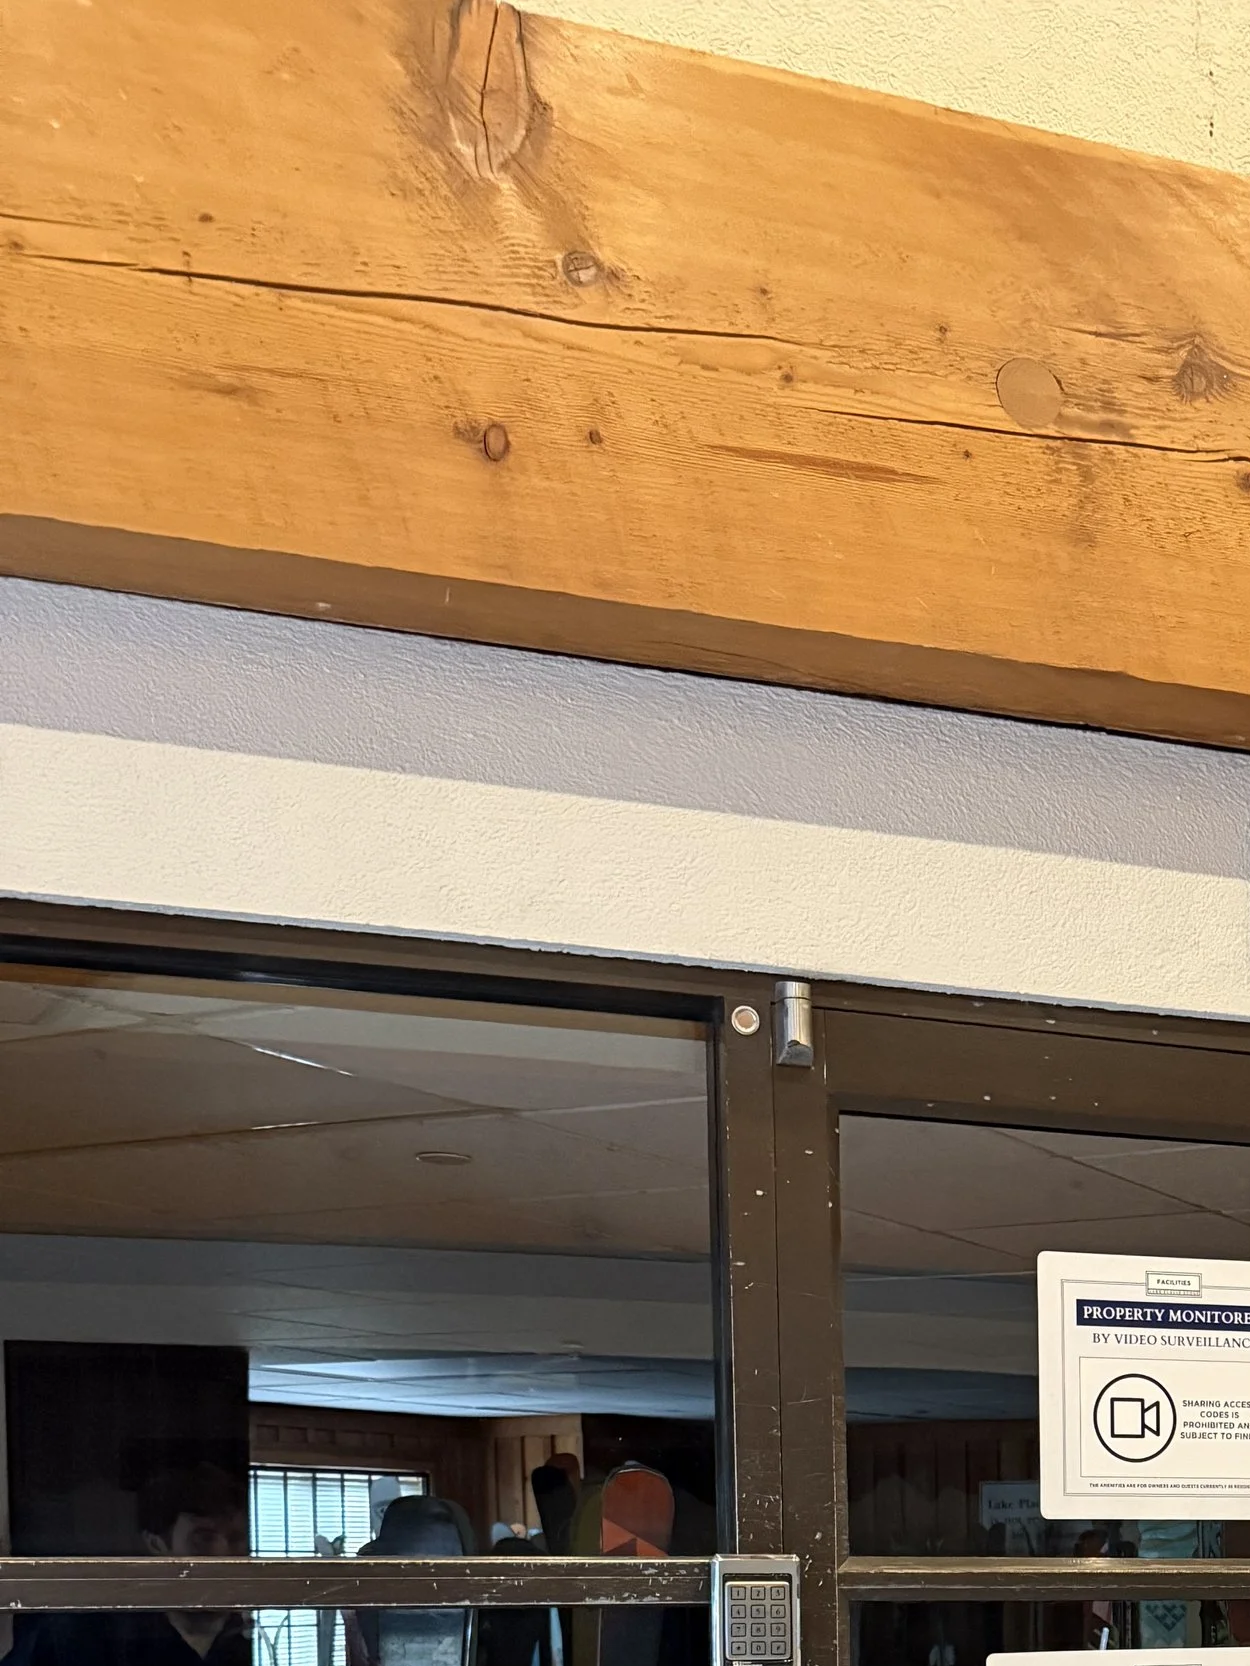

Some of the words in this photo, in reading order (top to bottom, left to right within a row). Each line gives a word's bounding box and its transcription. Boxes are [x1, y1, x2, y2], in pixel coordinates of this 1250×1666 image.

[1084, 1306, 1164, 1321] PROPERTY
[1093, 1333, 1110, 1343] BY
[1115, 1334, 1157, 1345] VIDEO
[1184, 1421, 1234, 1429] PROHIBITED
